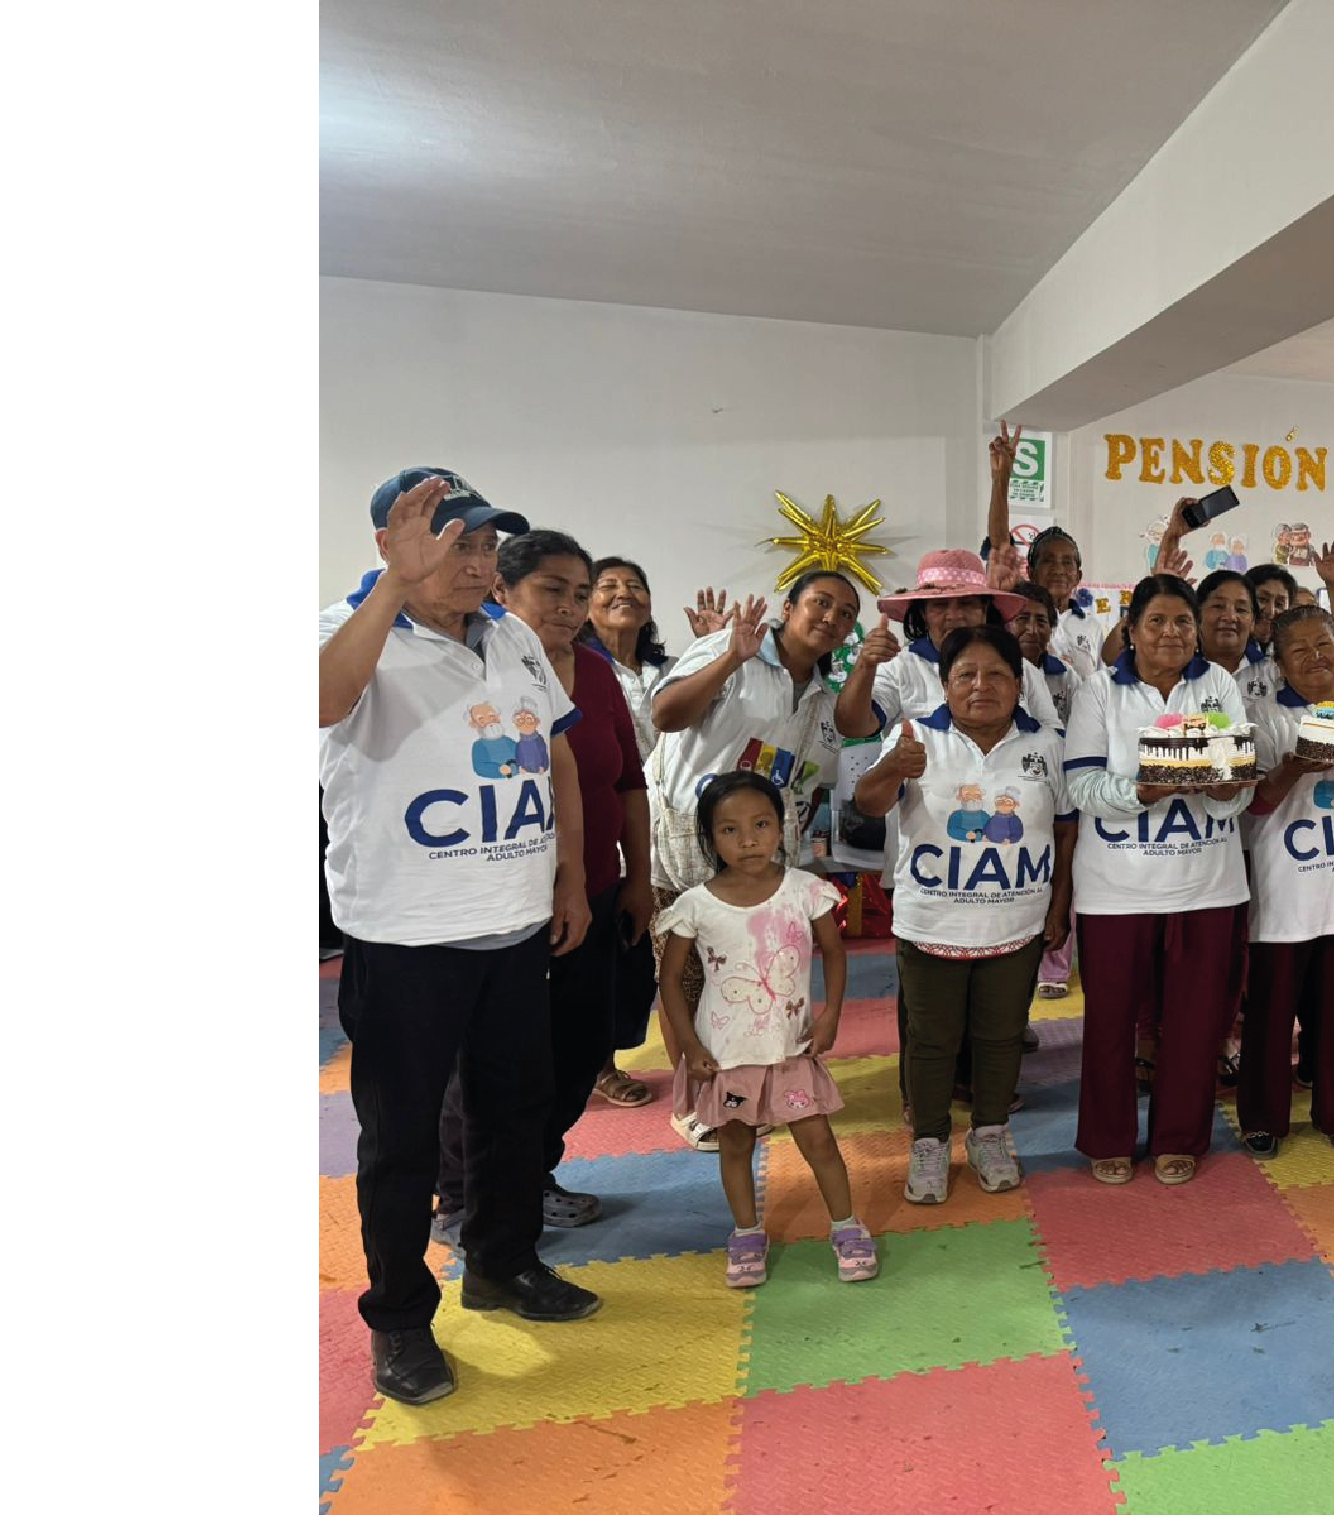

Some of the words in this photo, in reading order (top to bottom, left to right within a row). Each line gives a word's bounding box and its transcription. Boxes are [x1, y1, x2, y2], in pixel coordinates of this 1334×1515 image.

[1013, 441, 1039, 476] S
[1103, 424, 1328, 491] PENSIÓN
[405, 777, 555, 848] CIA
[428, 847, 478, 860] CENTRO
[910, 843, 1051, 891] CIAM
